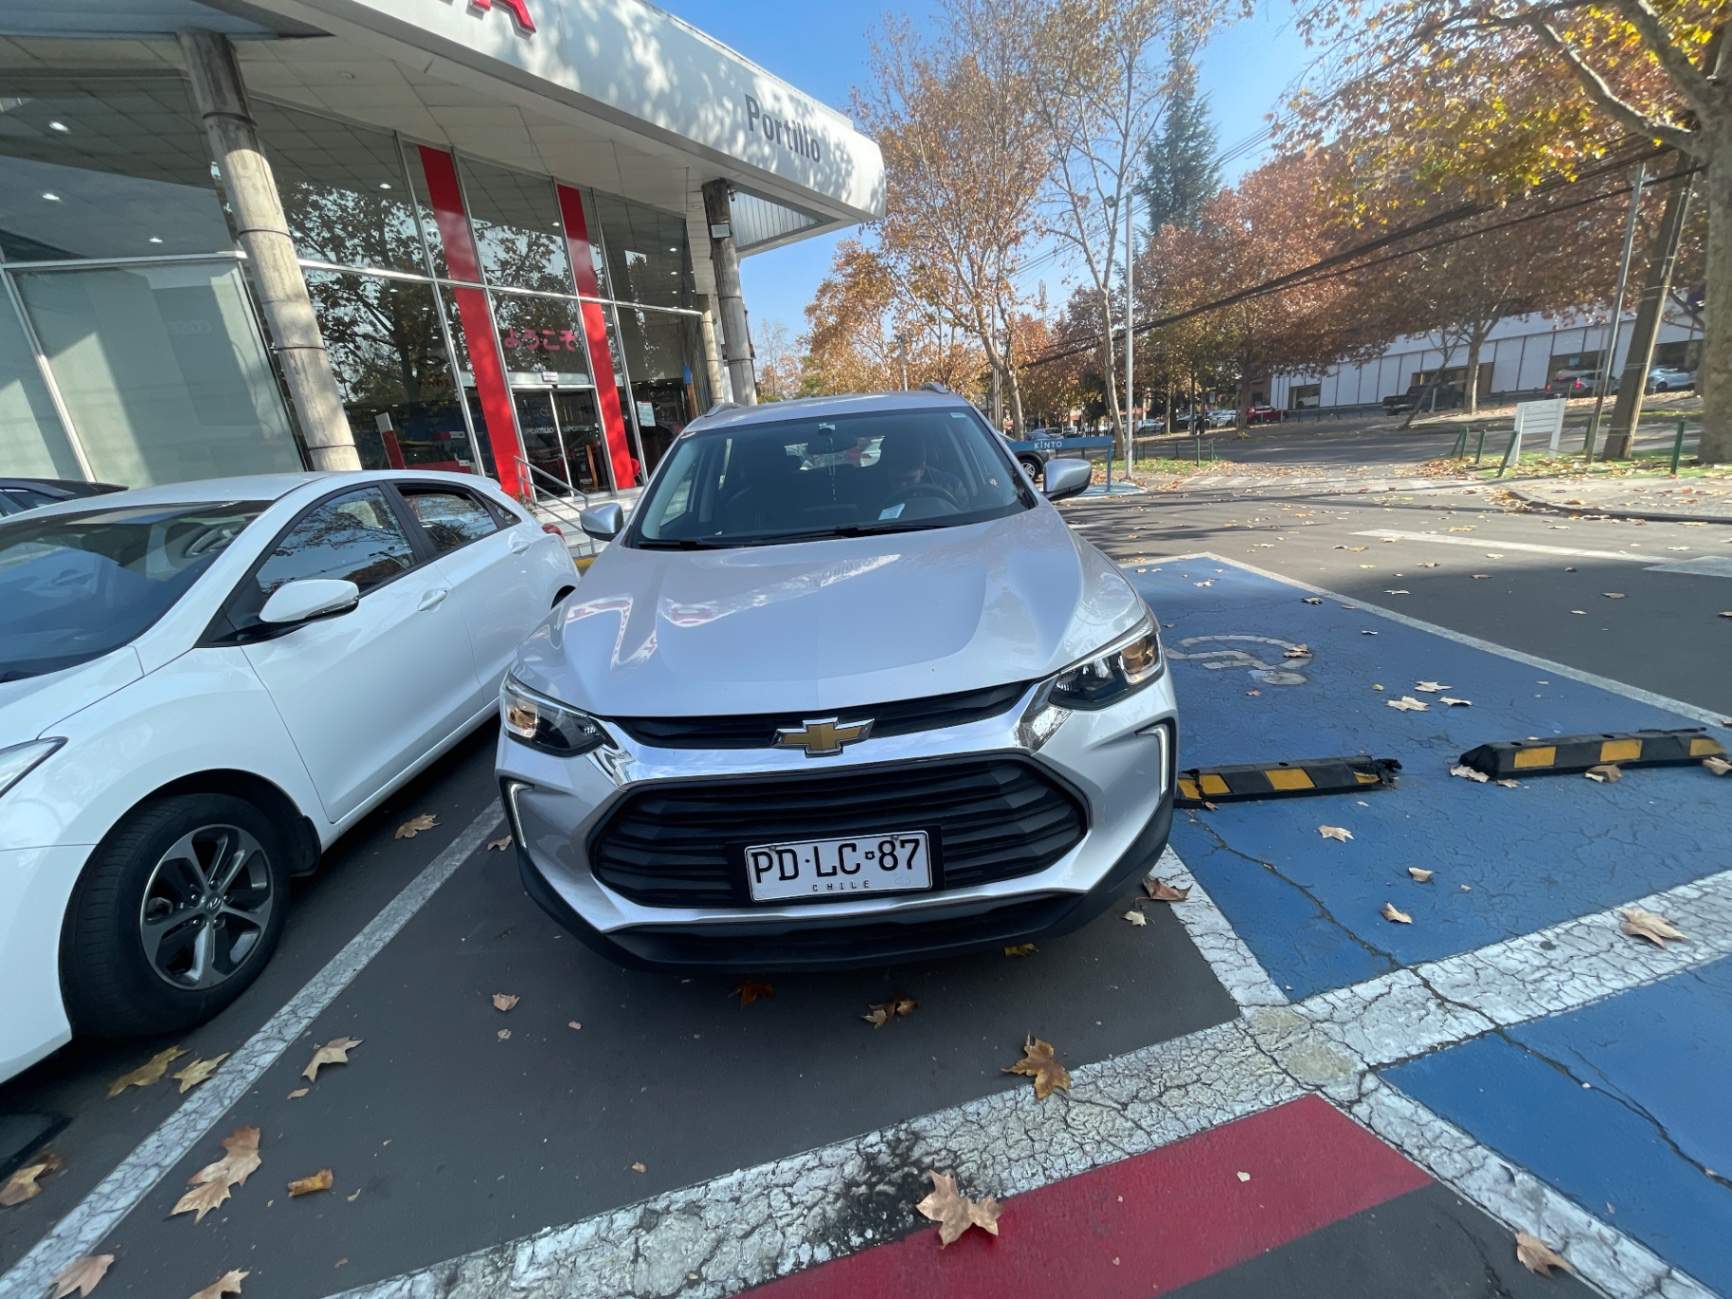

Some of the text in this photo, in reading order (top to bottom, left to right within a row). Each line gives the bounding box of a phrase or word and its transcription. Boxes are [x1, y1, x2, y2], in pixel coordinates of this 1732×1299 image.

[745, 94, 821, 163] Portillo
[503, 325, 577, 351] ようこそ
[1034, 440, 1063, 449] KINTO
[812, 880, 871, 892] CHILE
